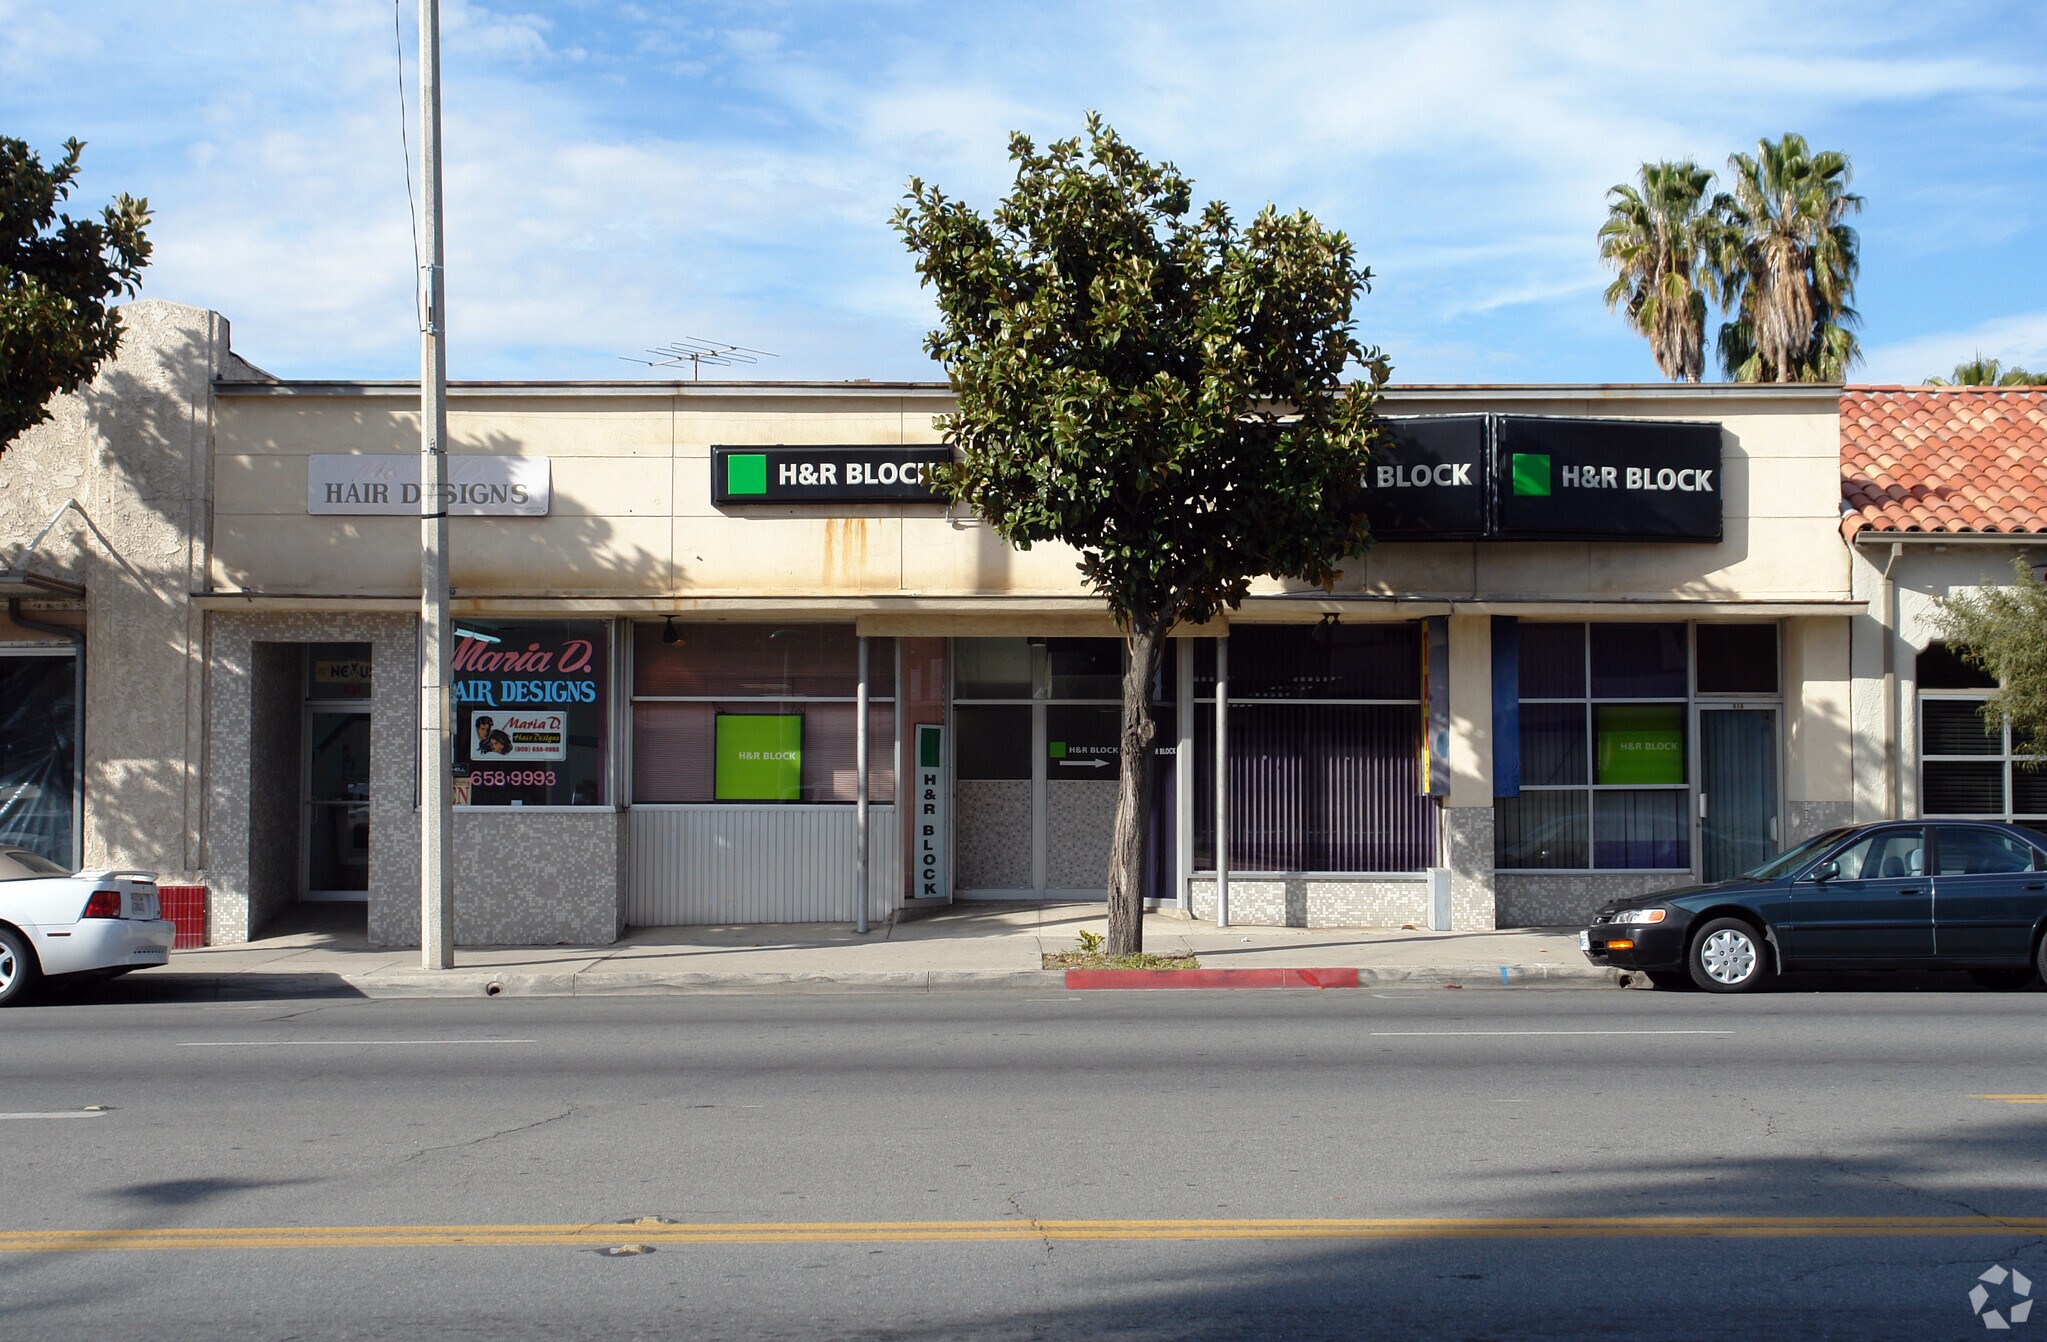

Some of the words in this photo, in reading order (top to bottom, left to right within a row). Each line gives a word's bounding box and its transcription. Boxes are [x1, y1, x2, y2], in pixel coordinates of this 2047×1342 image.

[779, 463, 838, 485] H&R
[1377, 463, 1472, 488] BLOCK
[1562, 465, 1618, 488] H&R
[1626, 467, 1713, 491] BLOCK
[325, 482, 389, 503] HAIR
[402, 483, 529, 504] DSIGNS
[450, 637, 553, 672] Maria
[456, 680, 500, 707] AIR
[501, 680, 597, 703] DESIGNS
[502, 717, 547, 731] Maria
[534, 733, 560, 743] Designs
[1620, 742, 1642, 750] H&R
[1645, 742, 1678, 750] BLOCK
[738, 751, 760, 760] H&R
[763, 751, 796, 760] BLOCK
[1069, 746, 1088, 754] H&R
[1090, 746, 1119, 754] BLOCK
[1159, 747, 1176, 755] BLOCK
[923, 774, 937, 815] H&R
[922, 824, 937, 895] BLOCK
